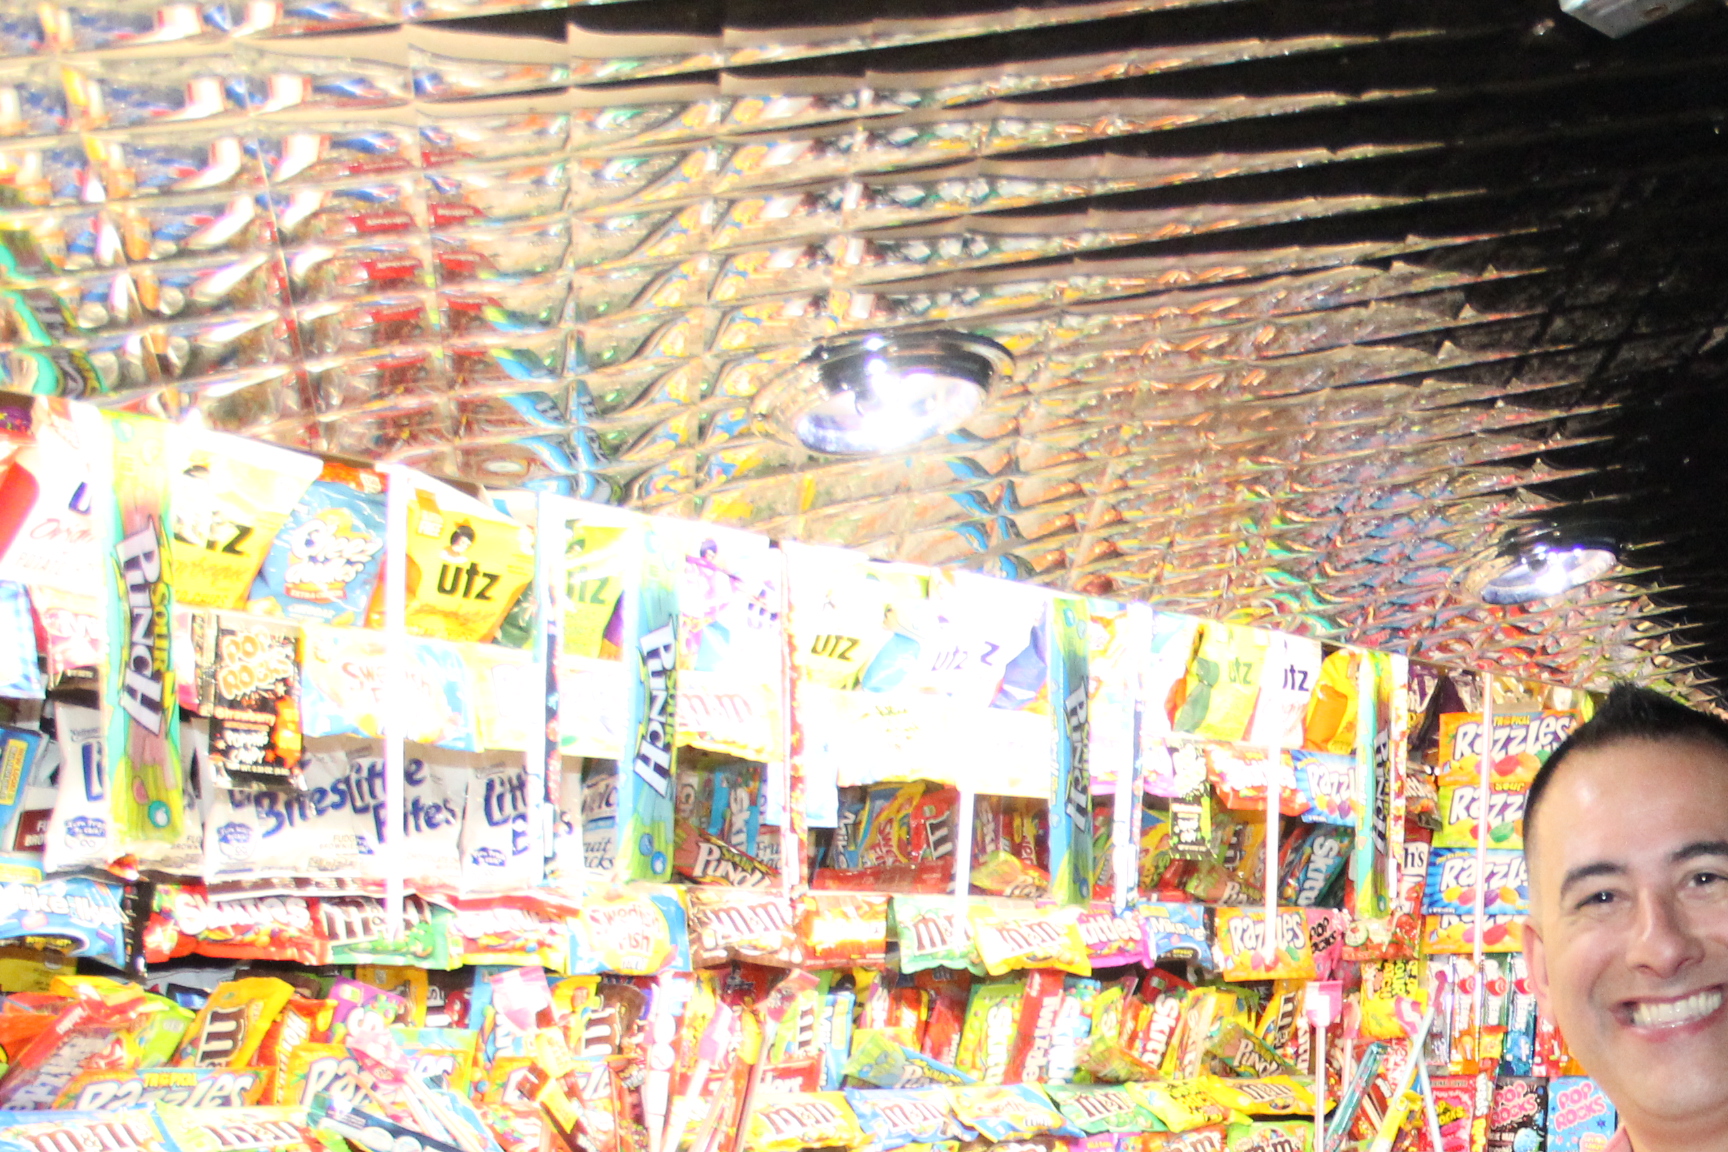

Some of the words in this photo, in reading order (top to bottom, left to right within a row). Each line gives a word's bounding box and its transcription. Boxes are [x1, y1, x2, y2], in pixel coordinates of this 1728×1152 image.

[436, 561, 501, 601] utz
[213, 705, 277, 727] Strawberry
[1492, 715, 1531, 727] TROPICAL
[1449, 785, 1526, 829] Razz
[1556, 1080, 1595, 1111] POP
[1554, 1095, 1608, 1132] ROCKS
